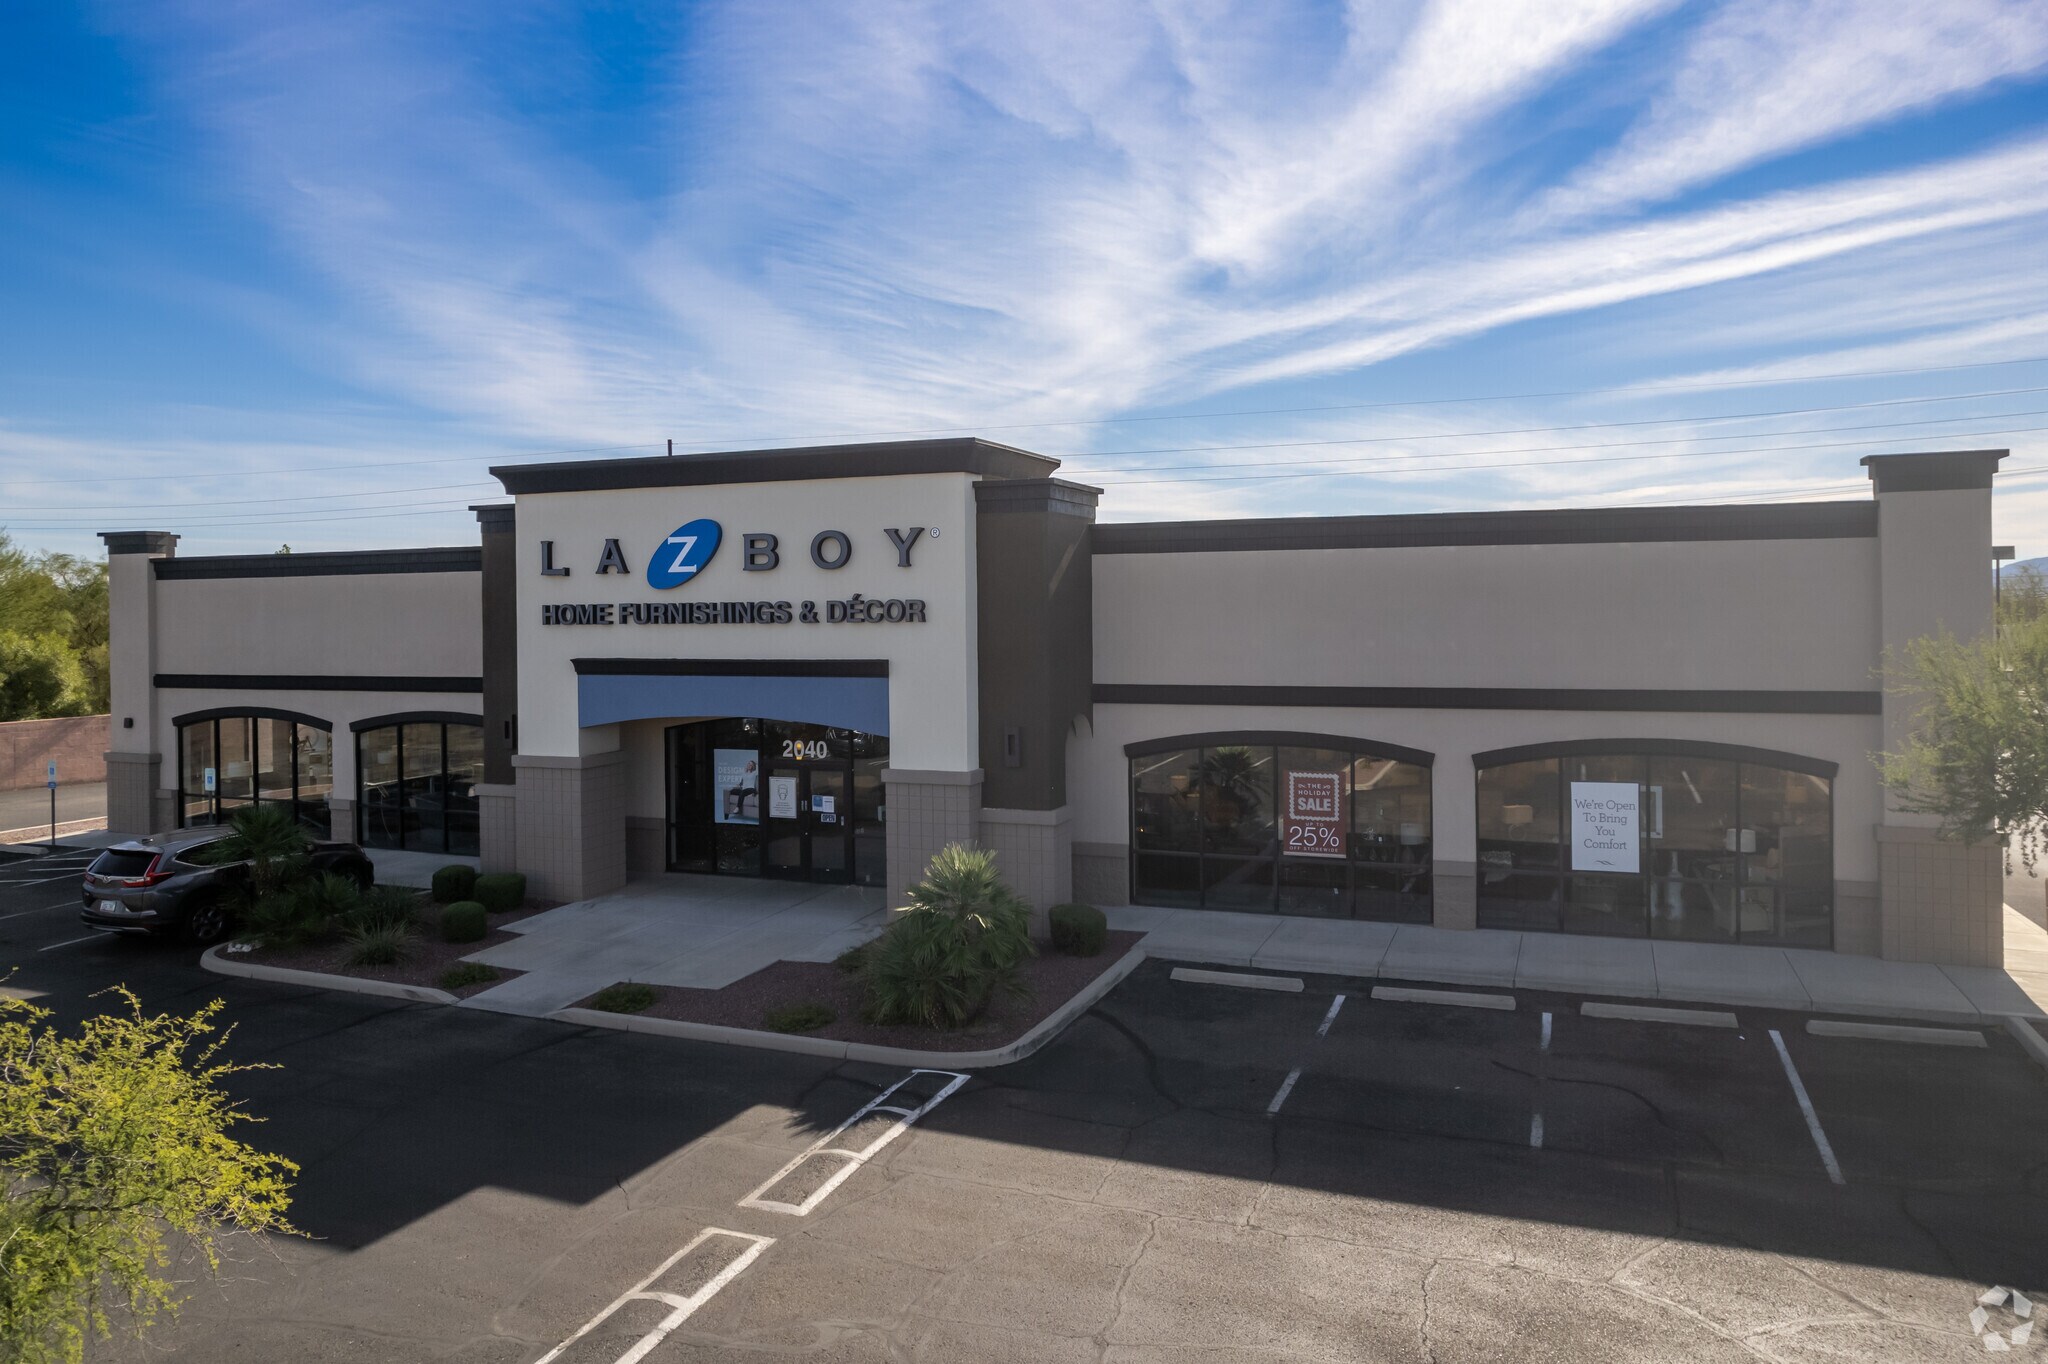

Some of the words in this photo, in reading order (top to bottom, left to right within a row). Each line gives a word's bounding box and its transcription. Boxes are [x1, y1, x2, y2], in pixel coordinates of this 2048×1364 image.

[541, 603, 614, 625] HOME
[618, 600, 793, 624] FURNISHINGS
[800, 602, 820, 624] &
[826, 593, 927, 623] DÉCOR
[782, 739, 828, 759] 2040
[1298, 797, 1331, 811] SALE
[1574, 799, 1604, 810] We're
[1606, 800, 1636, 812] Open
[1583, 812, 1597, 823] To
[1599, 813, 1628, 825] Bring
[1290, 826, 1339, 846] 25%
[1595, 826, 1616, 836] You
[1584, 839, 1627, 849] Comfort
